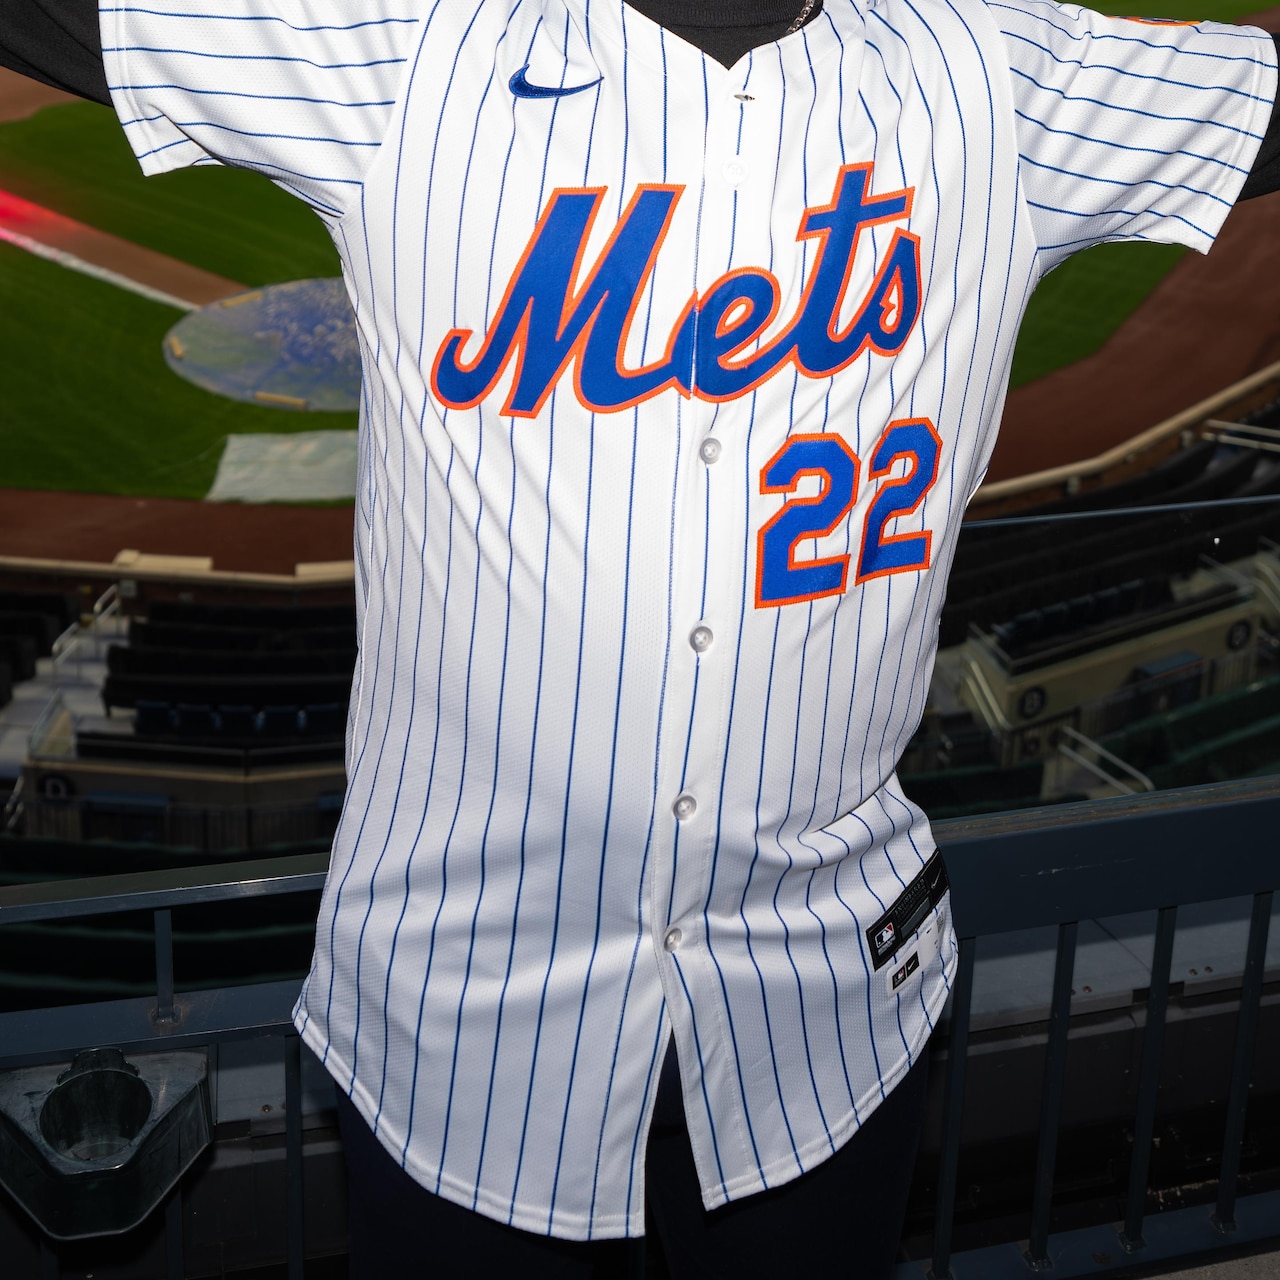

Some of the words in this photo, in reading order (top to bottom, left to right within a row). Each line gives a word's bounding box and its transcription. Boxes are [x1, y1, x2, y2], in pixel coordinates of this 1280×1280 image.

[431, 162, 921, 418] Mets
[755, 417, 943, 608] 22
[46, 777, 68, 799] D
